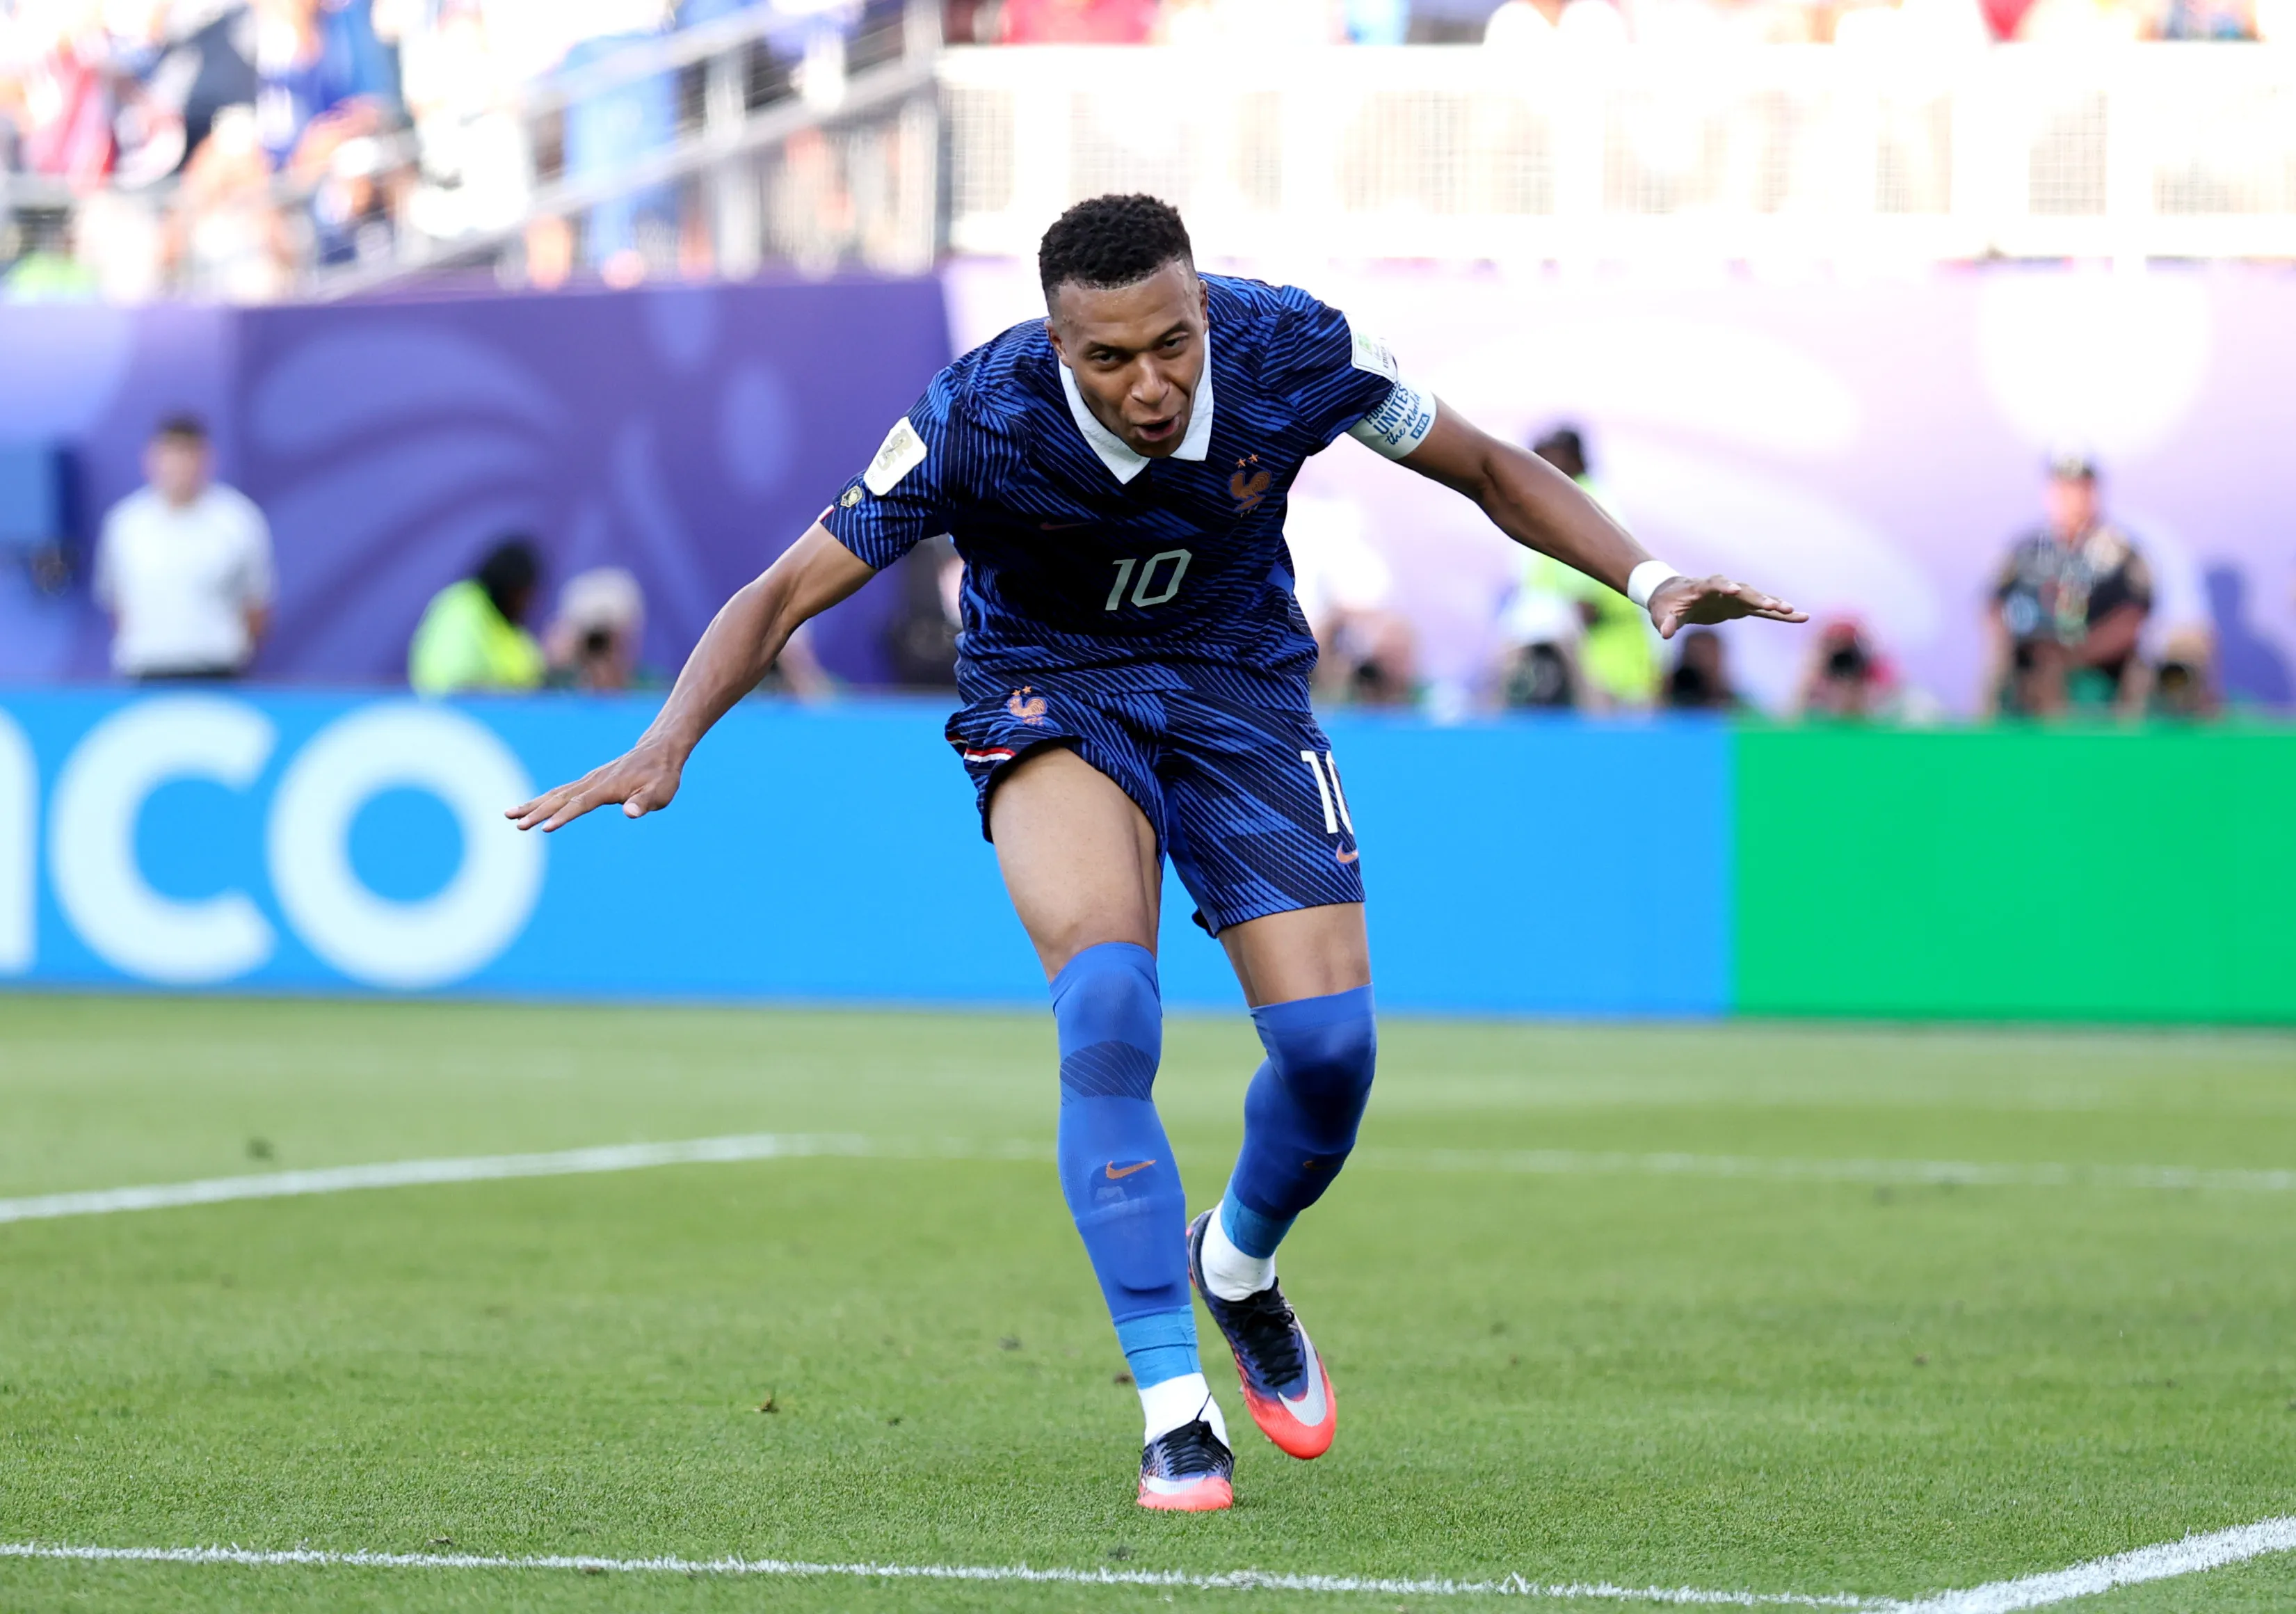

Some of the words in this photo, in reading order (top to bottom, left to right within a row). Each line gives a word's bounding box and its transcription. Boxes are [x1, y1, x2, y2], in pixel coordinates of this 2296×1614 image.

[1373, 384, 1408, 434] UNITES
[1385, 428, 1406, 445] the
[1402, 390, 1421, 427] World
[1411, 413, 1430, 438] FIFA
[1105, 549, 1192, 611] 10
